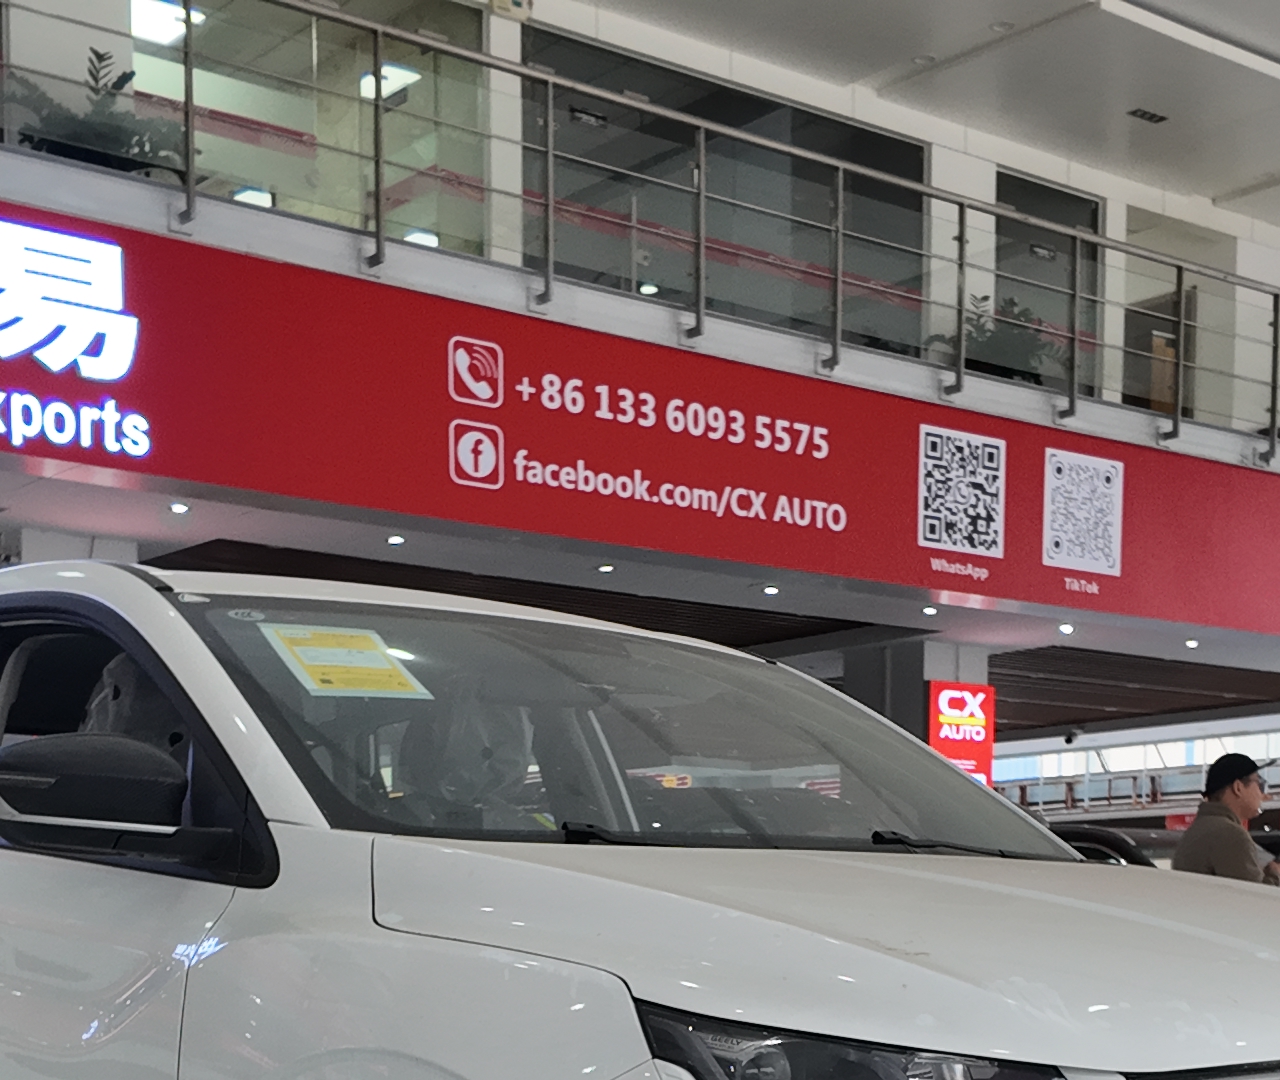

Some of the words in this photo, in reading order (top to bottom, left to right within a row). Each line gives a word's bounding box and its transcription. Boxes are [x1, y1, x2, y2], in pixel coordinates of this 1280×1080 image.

[515, 373, 585, 414] +86
[594, 384, 656, 427] 133
[665, 398, 746, 444] 6093
[754, 415, 830, 459] 5575
[514, 449, 767, 520] facebook.com/CX
[772, 495, 847, 532] AUTO
[930, 557, 989, 581] WhatsApp
[1064, 577, 1099, 595] TikTok
[938, 689, 986, 719] CX
[939, 724, 986, 741] AUTO
